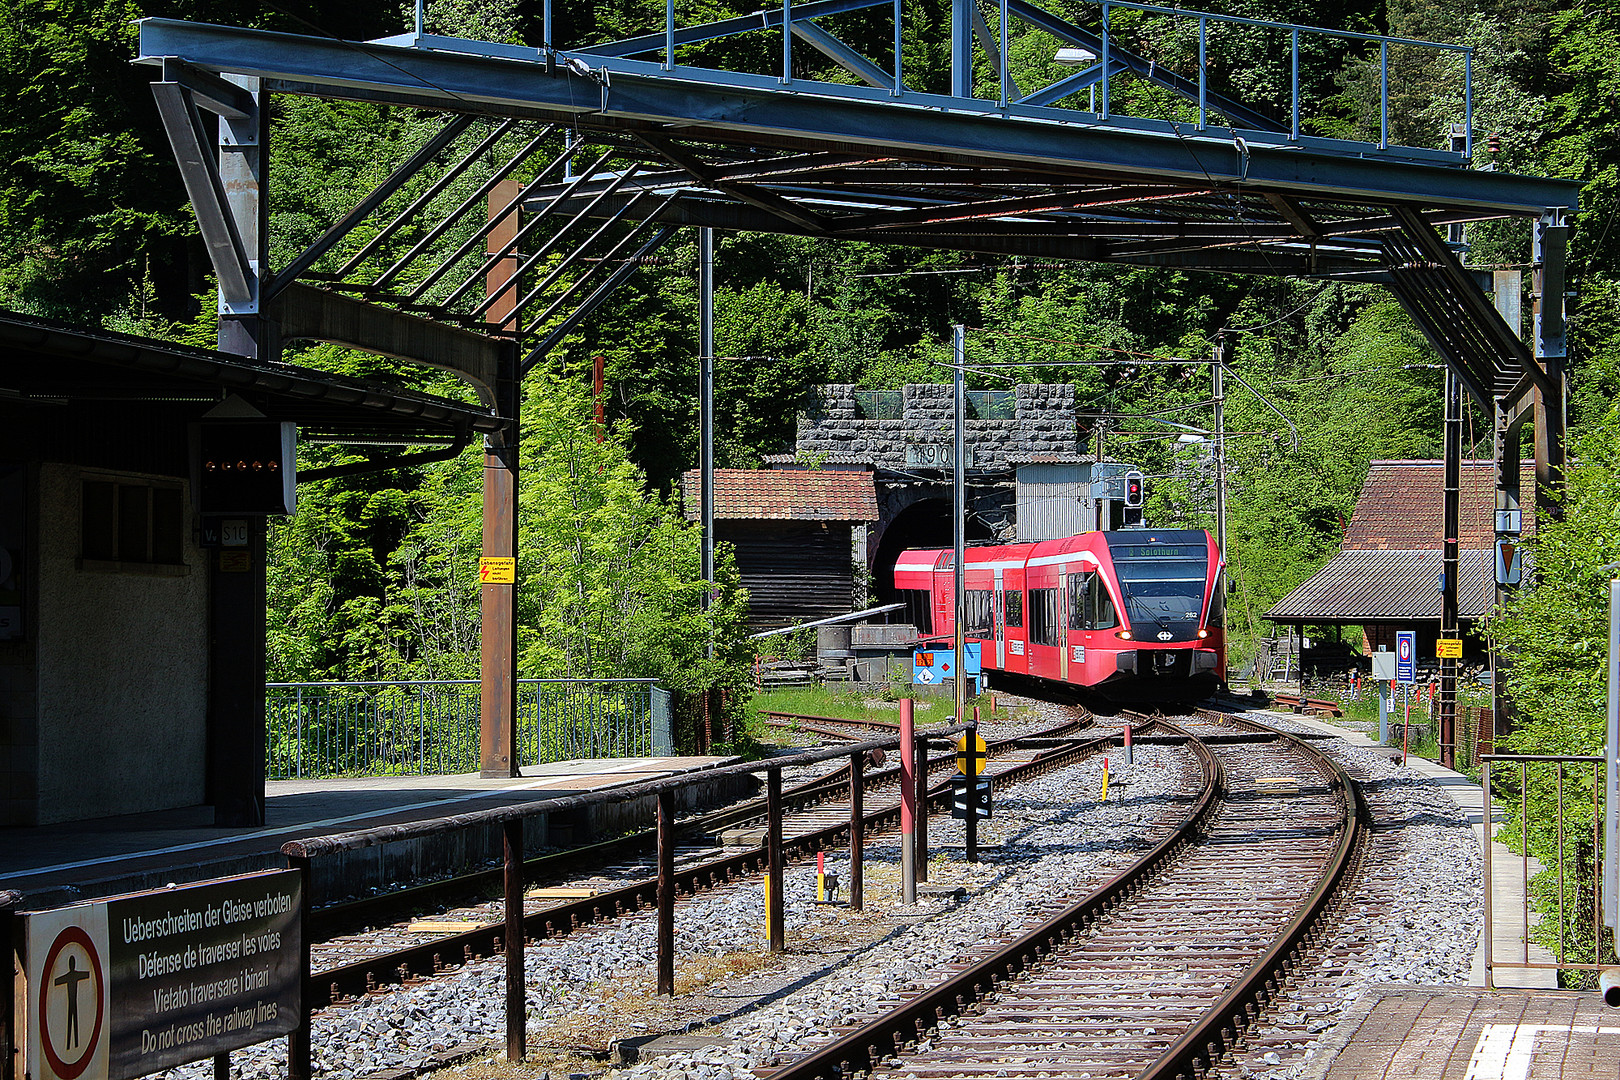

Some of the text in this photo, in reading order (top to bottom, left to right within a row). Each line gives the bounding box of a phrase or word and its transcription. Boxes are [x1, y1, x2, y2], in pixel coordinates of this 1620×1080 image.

[223, 526, 246, 541] S1C
[1504, 512, 1513, 530] 1
[1140, 547, 1179, 556] Solothurn
[981, 795, 988, 804] 3
[123, 892, 292, 944] Ueberschreiten der Gleise verboten
[139, 930, 281, 979] Défense de traverser les voies
[153, 964, 269, 1014] Vietato traversare i binari
[142, 1001, 278, 1054] Do not cross the railway lines
